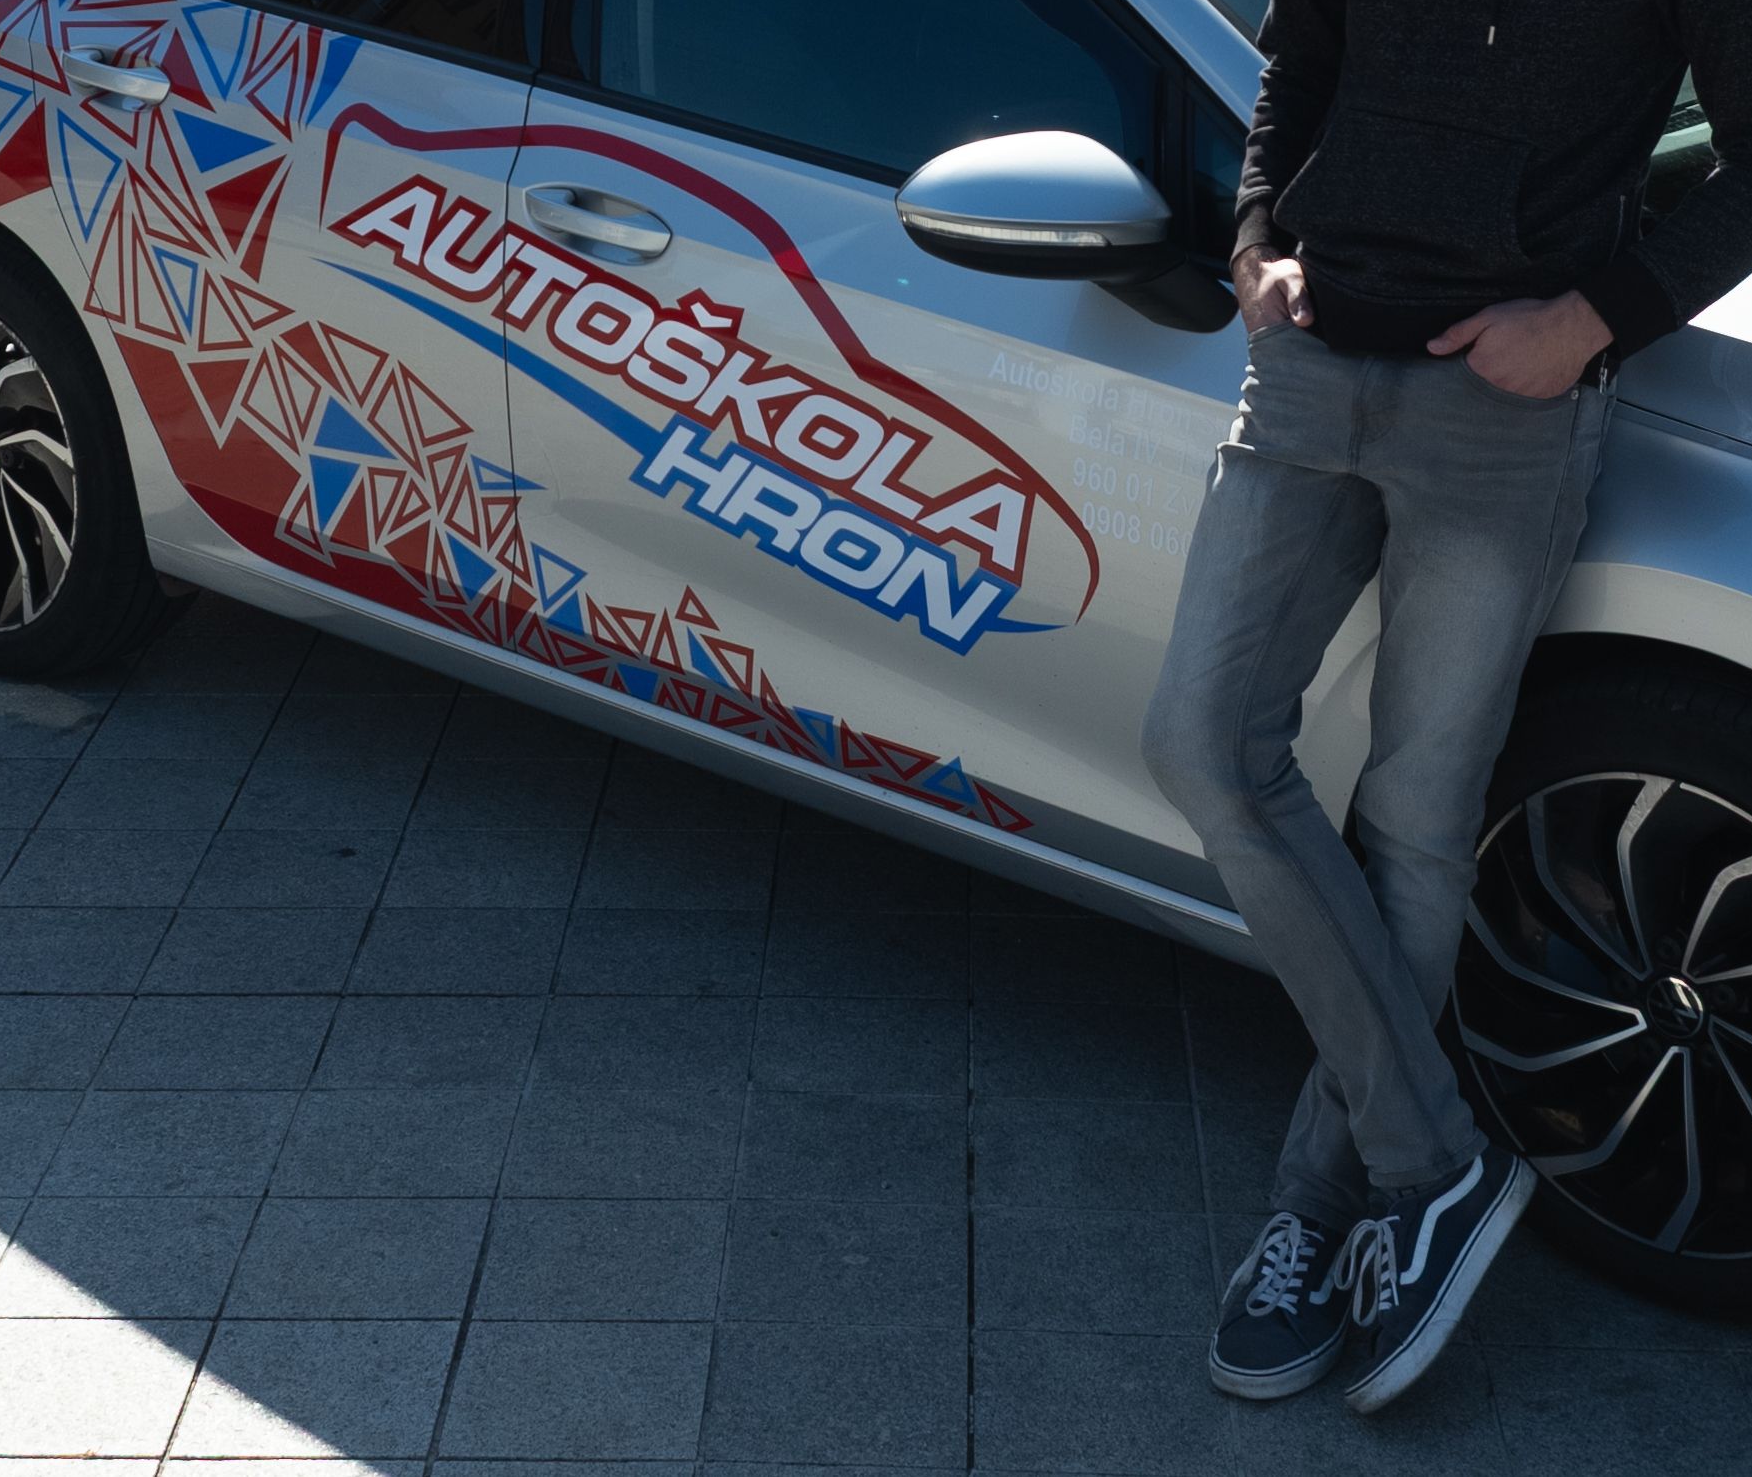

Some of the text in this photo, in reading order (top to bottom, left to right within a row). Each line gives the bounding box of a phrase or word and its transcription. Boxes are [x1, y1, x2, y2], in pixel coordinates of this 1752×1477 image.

[344, 180, 1035, 577] AUTOŠKOLA
[642, 433, 1004, 644] HRON
[1072, 457, 1117, 496] 960
[1125, 473, 1156, 507] 01
[1082, 501, 1141, 545] 0908
